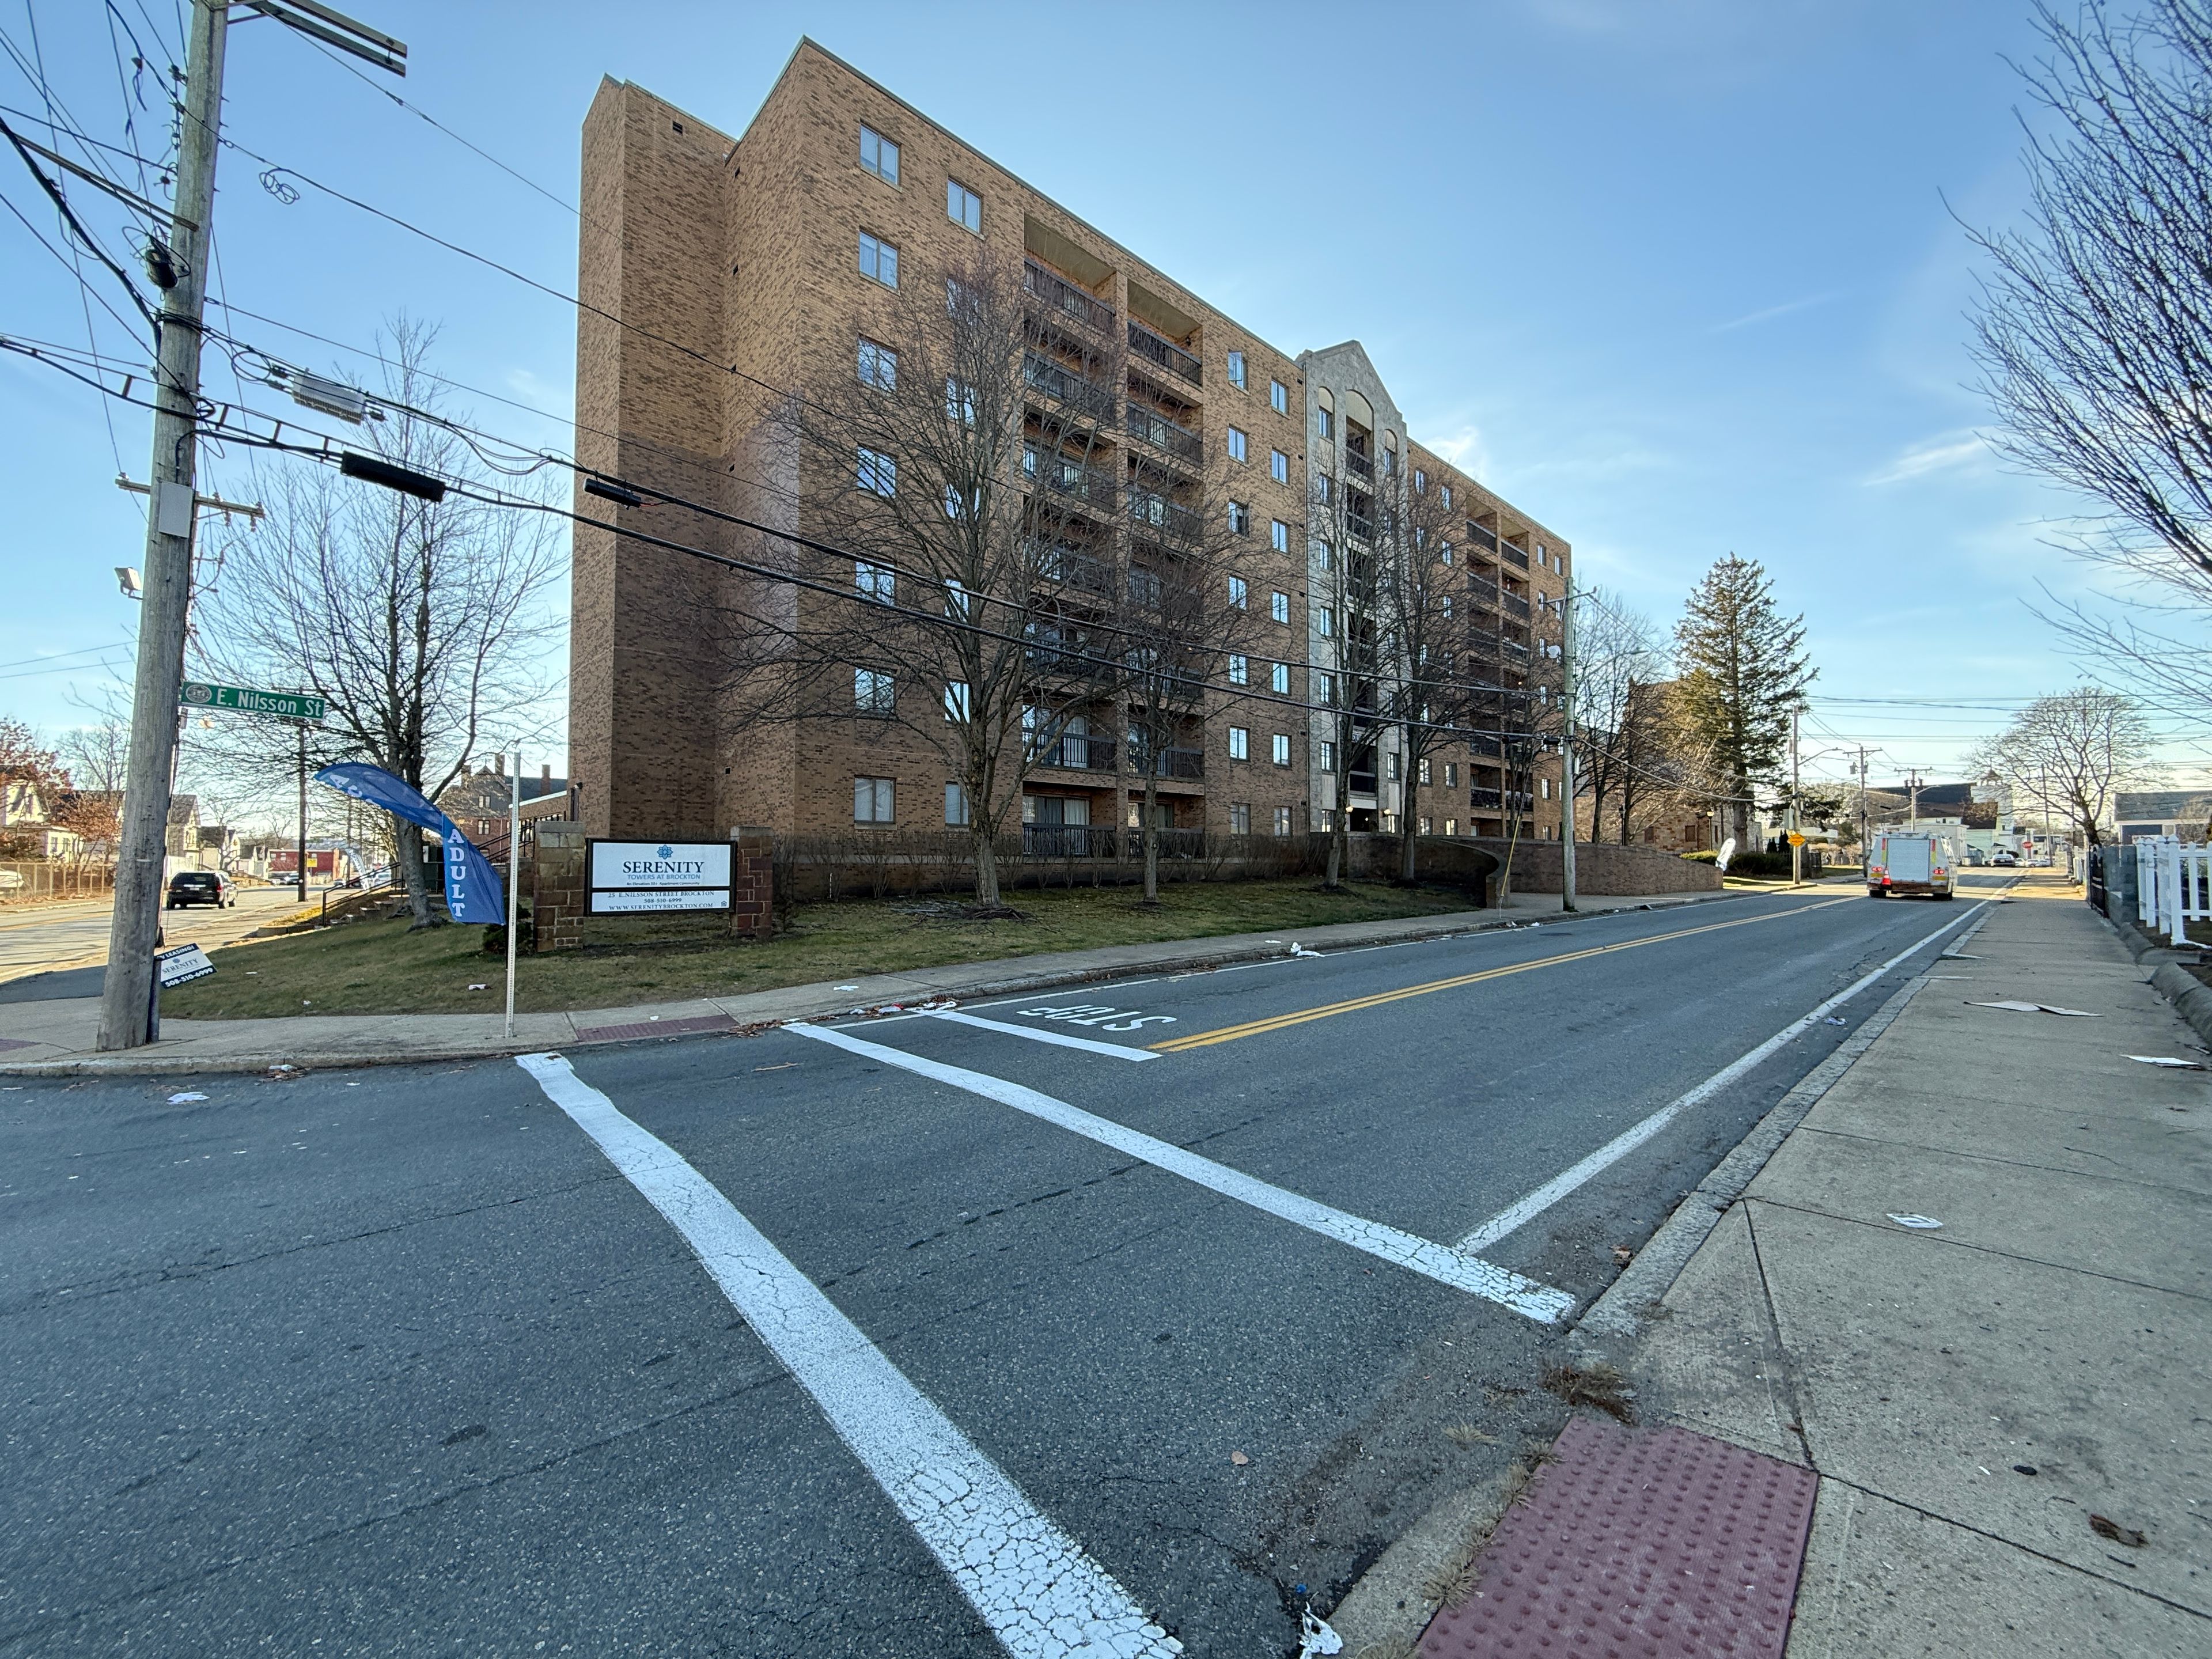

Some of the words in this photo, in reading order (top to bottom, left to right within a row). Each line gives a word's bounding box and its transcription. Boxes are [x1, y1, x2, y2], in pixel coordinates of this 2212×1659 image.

[217, 688, 232, 706] E.
[237, 691, 297, 714] Nilsson
[304, 699, 321, 717] St
[448, 828, 466, 917] ADULT
[623, 861, 704, 873] SERENITY
[162, 958, 198, 974] SERENITY
[165, 968, 213, 987] 508-510-6999
[1016, 1005, 1177, 1032] STOP
